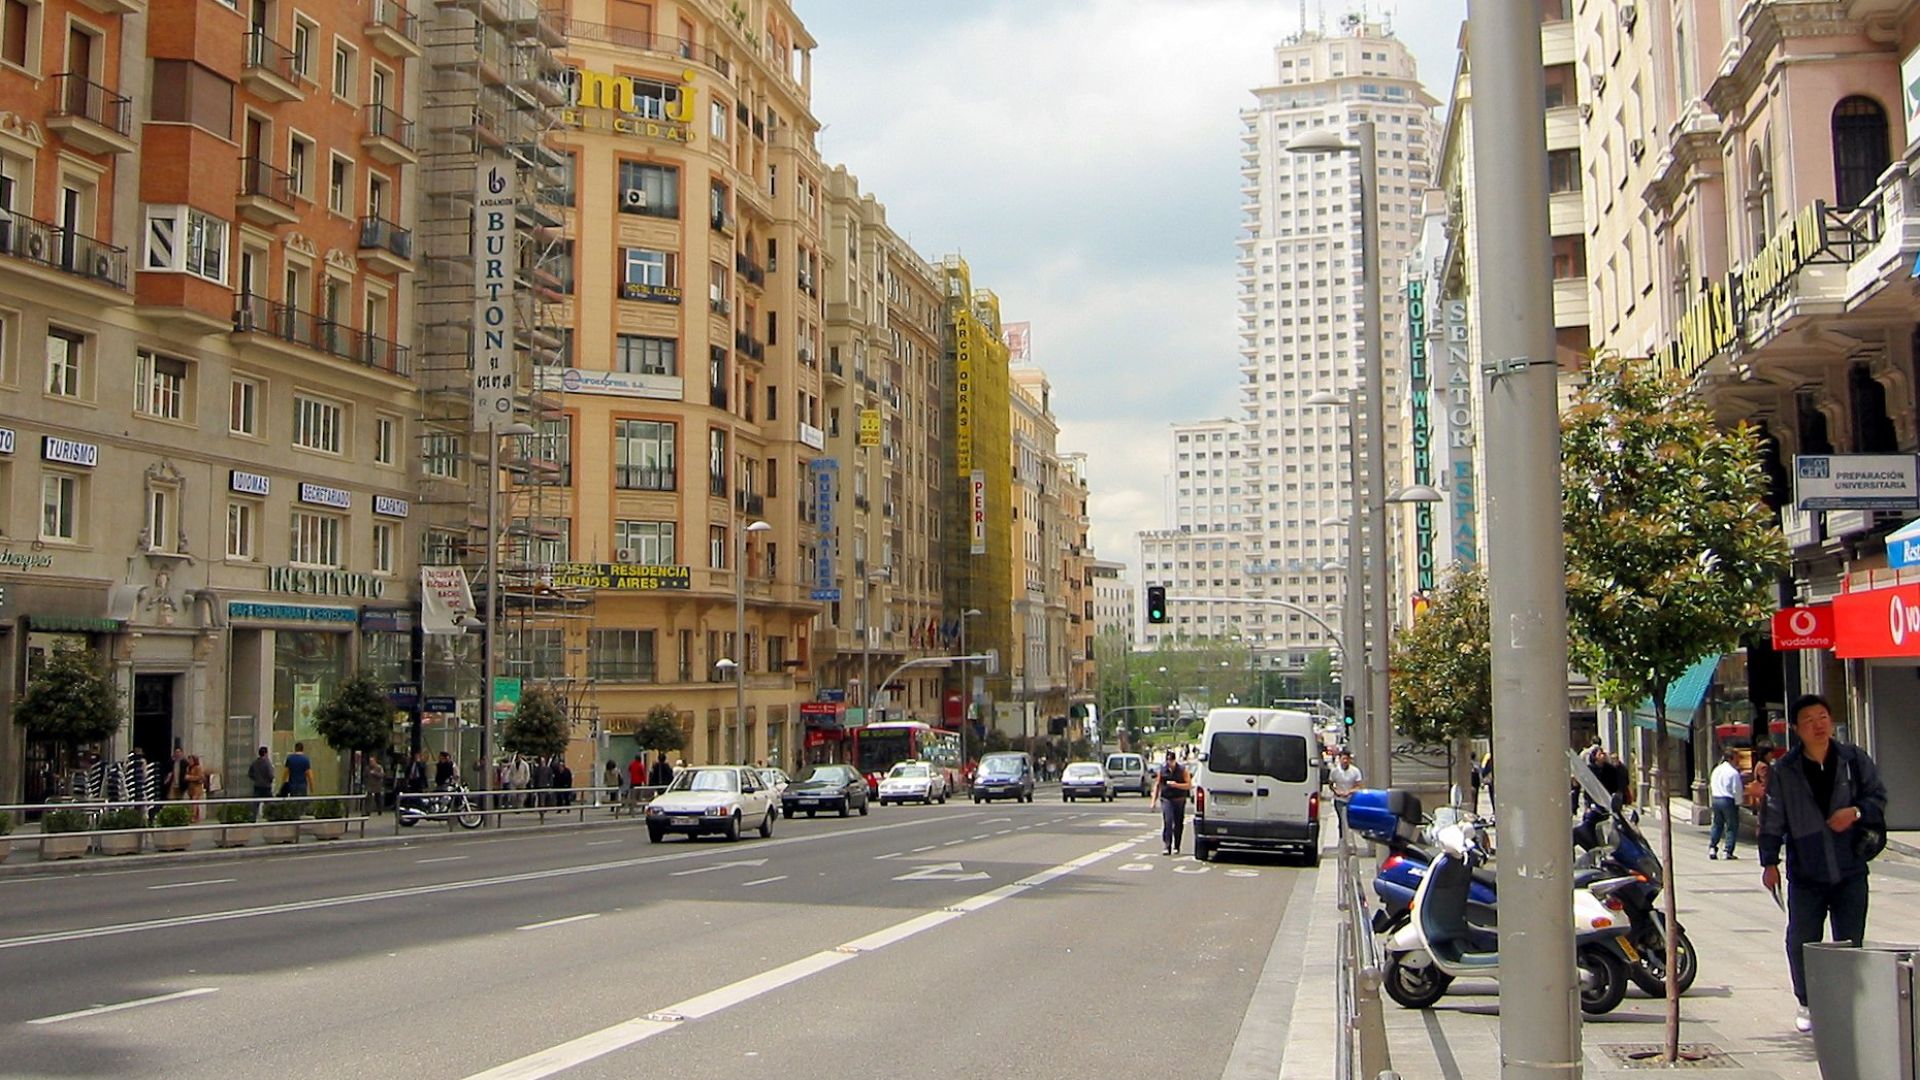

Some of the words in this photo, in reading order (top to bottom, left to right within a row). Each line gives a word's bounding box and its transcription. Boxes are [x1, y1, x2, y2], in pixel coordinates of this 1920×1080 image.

[485, 212, 505, 350] BURTON
[959, 317, 967, 361] ARCO
[1408, 281, 1425, 378] HOTEL
[490, 357, 498, 370] 91
[1448, 303, 1472, 447] SENATOR
[49, 439, 95, 463] TURISMO
[235, 472, 268, 493] IDIOMAS
[1834, 481, 1907, 490] UNIVERSITARIA
[1836, 470, 1904, 480] PREPARACIÓN
[304, 485, 350, 506] SECRETARIADO
[378, 497, 407, 515] AZAFATAS
[820, 473, 830, 533] BUENOS
[975, 482, 983, 537] PERI
[610, 565, 689, 578] RESIDENCIA
[820, 539, 830, 588] AIRES
[269, 566, 385, 599] INSTITUTO
[616, 577, 659, 589] AIRES
[1780, 637, 1829, 647] vodafone
[1117, 862, 1261, 878] BUS
